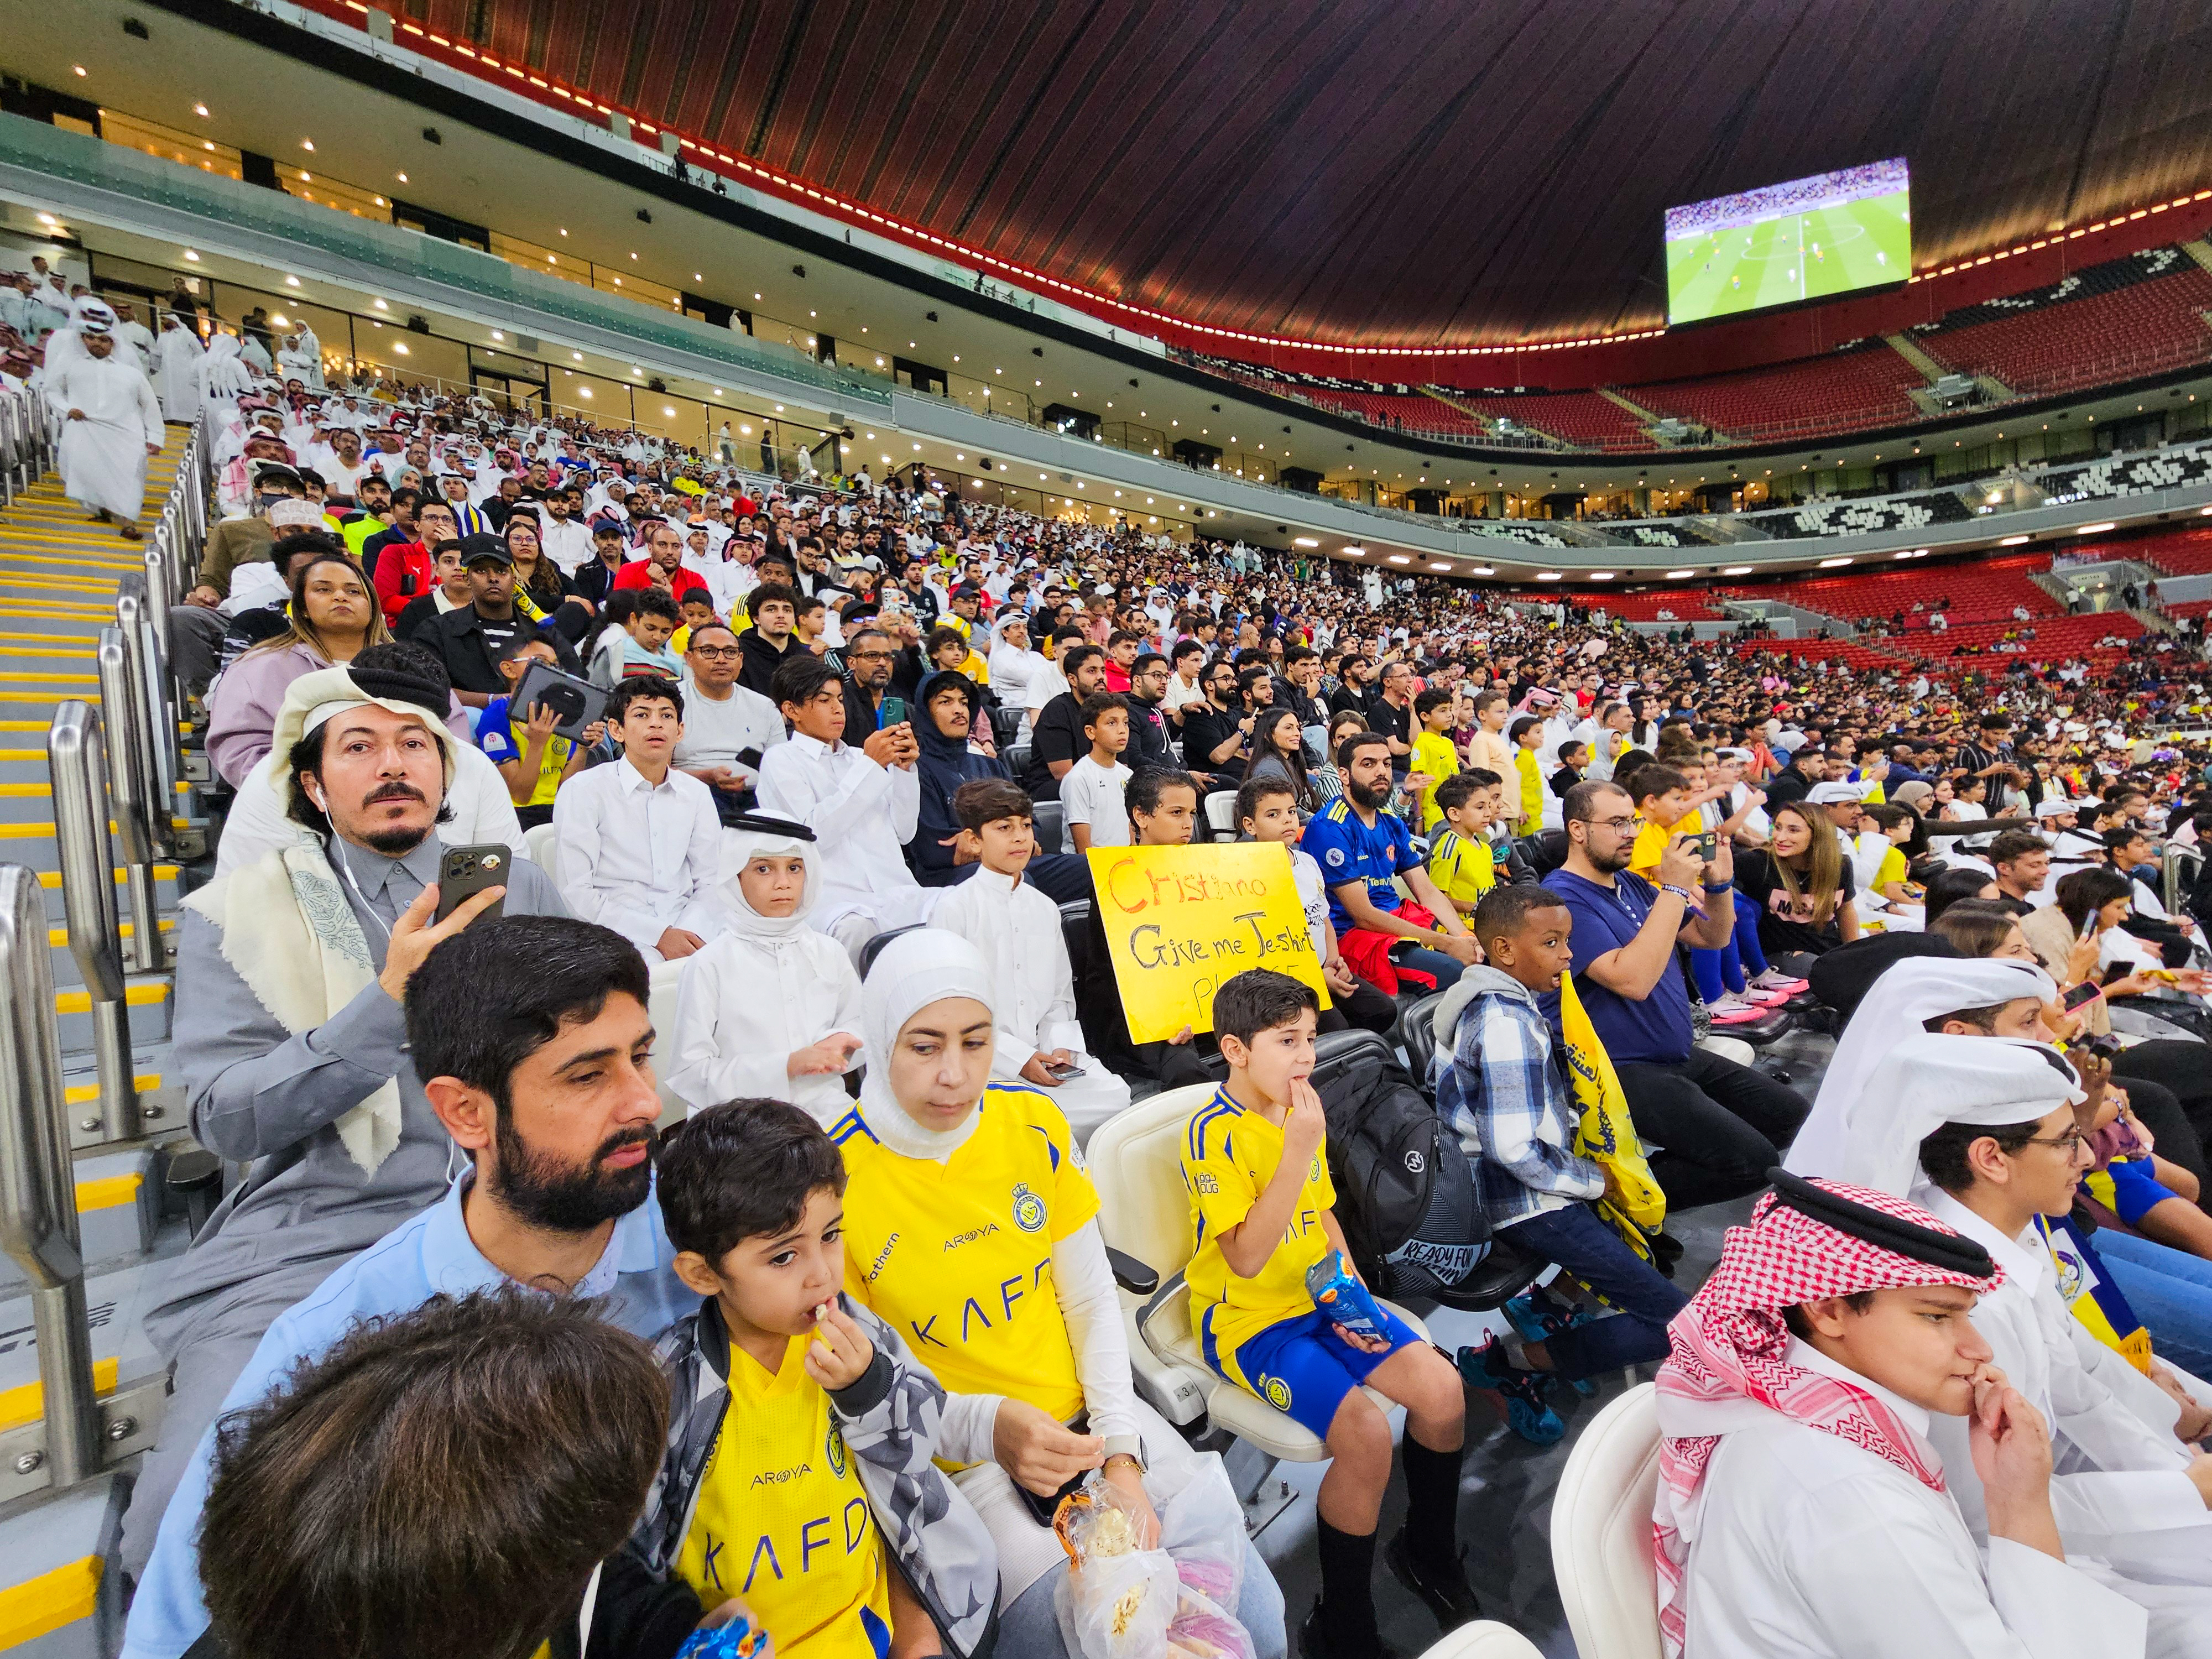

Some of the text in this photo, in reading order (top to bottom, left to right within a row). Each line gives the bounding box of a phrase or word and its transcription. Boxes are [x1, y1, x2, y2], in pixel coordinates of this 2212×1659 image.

[1109, 856, 1266, 914] Cristiano
[1130, 924, 1209, 969] Give
[1213, 939, 1246, 958] me
[1234, 911, 1316, 959] Te-shirt
[867, 1233, 900, 1284] athern
[944, 1223, 1000, 1253] AROYA
[1402, 1241, 1455, 1266] READY
[910, 1256, 1051, 1348] KAFD
[1182, 1387, 1190, 1397] 3
[750, 1463, 812, 1491] AROYA
[703, 1497, 868, 1593] KAFD
